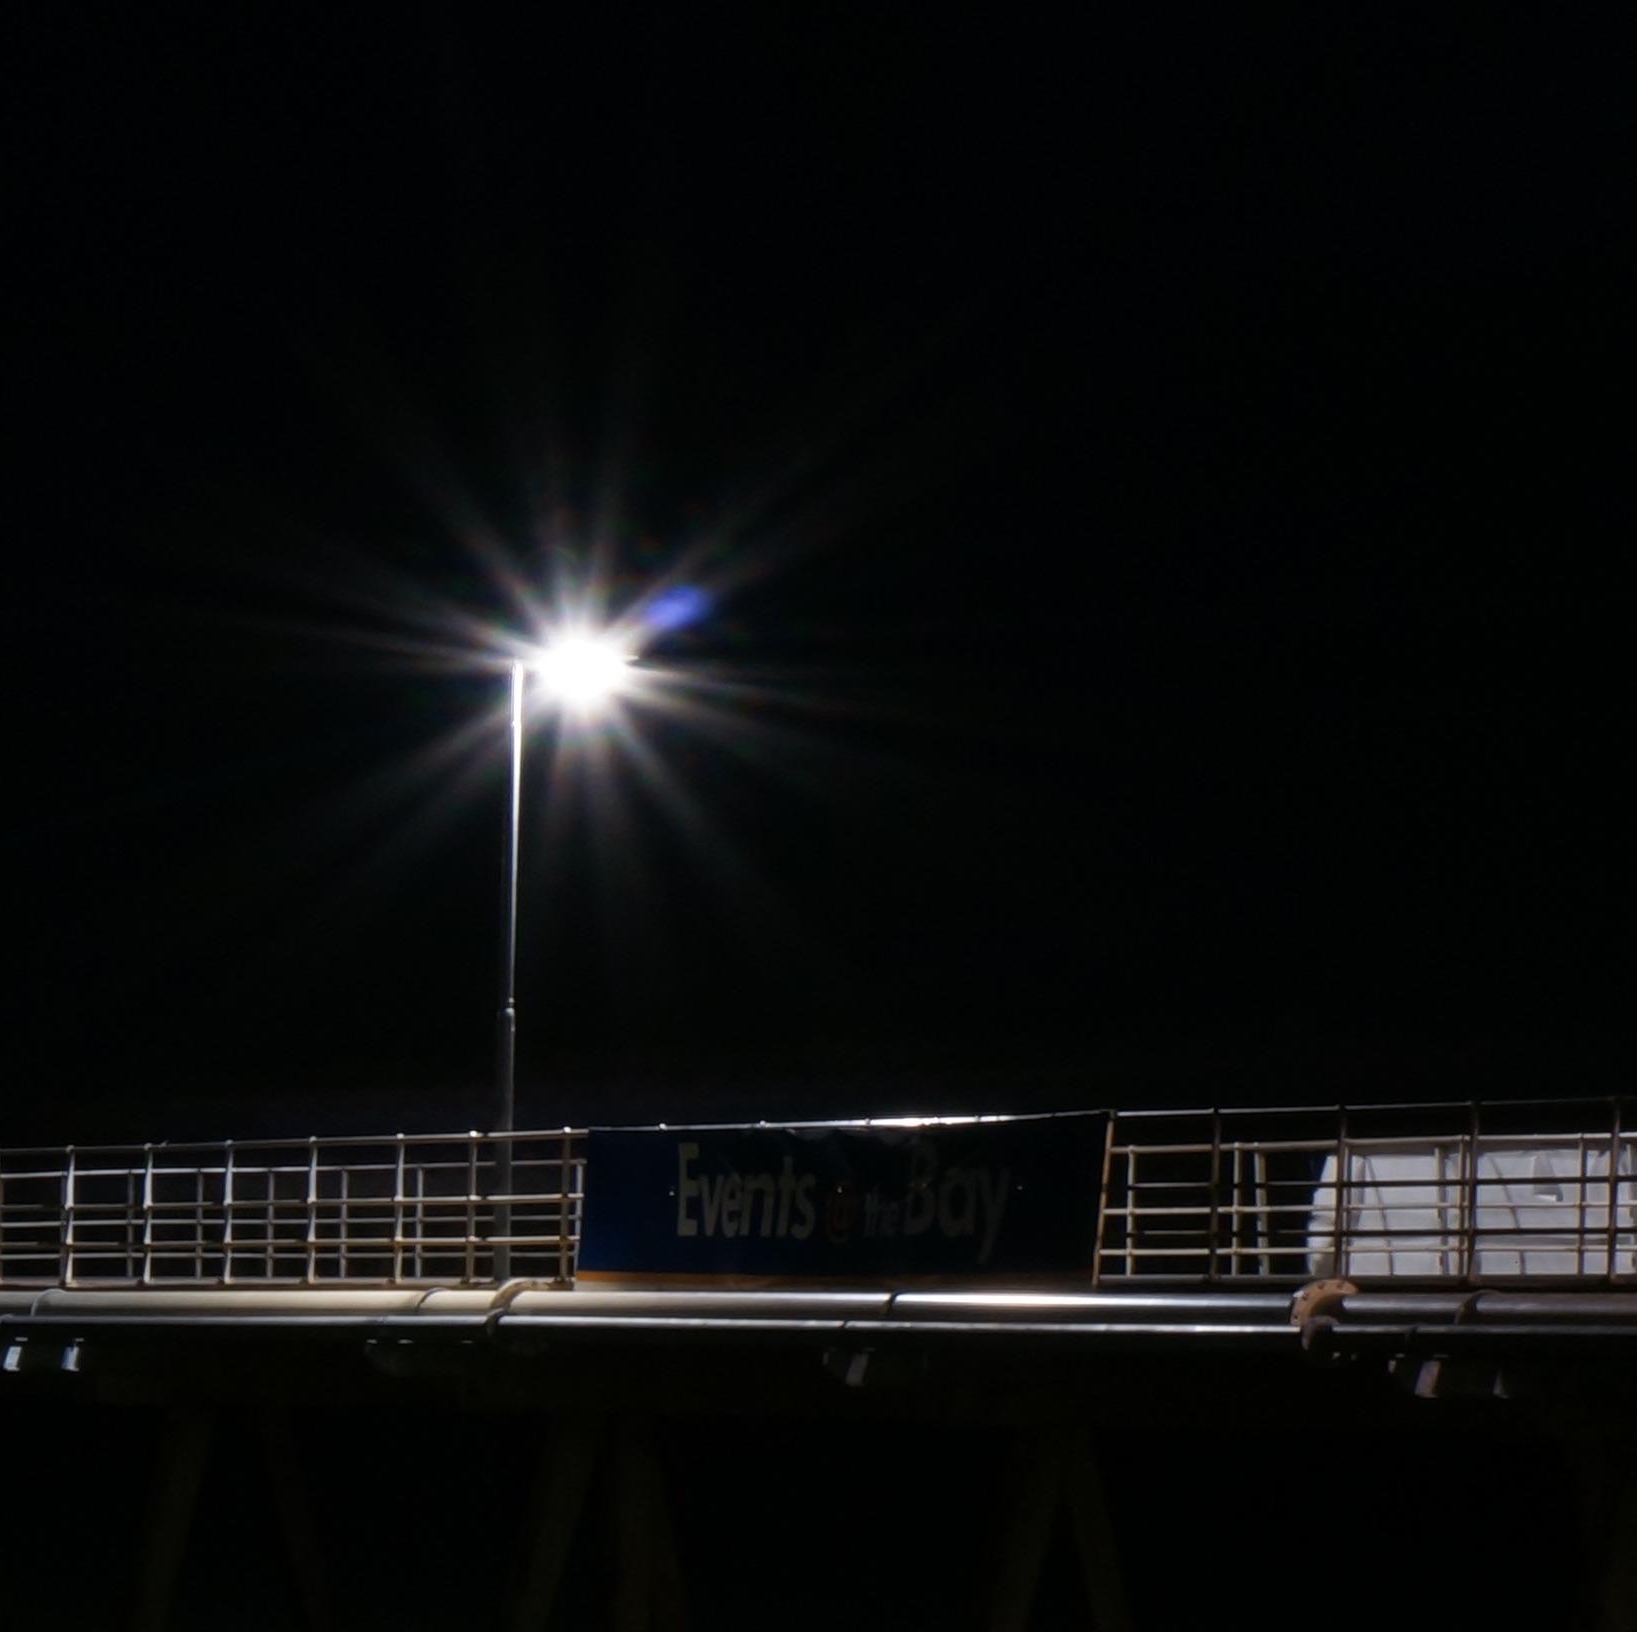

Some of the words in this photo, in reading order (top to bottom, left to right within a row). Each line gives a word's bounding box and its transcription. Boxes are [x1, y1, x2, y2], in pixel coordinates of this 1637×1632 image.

[676, 1141, 817, 1240] Events
[864, 1190, 899, 1237] the
[905, 1136, 1012, 1264] Bay
